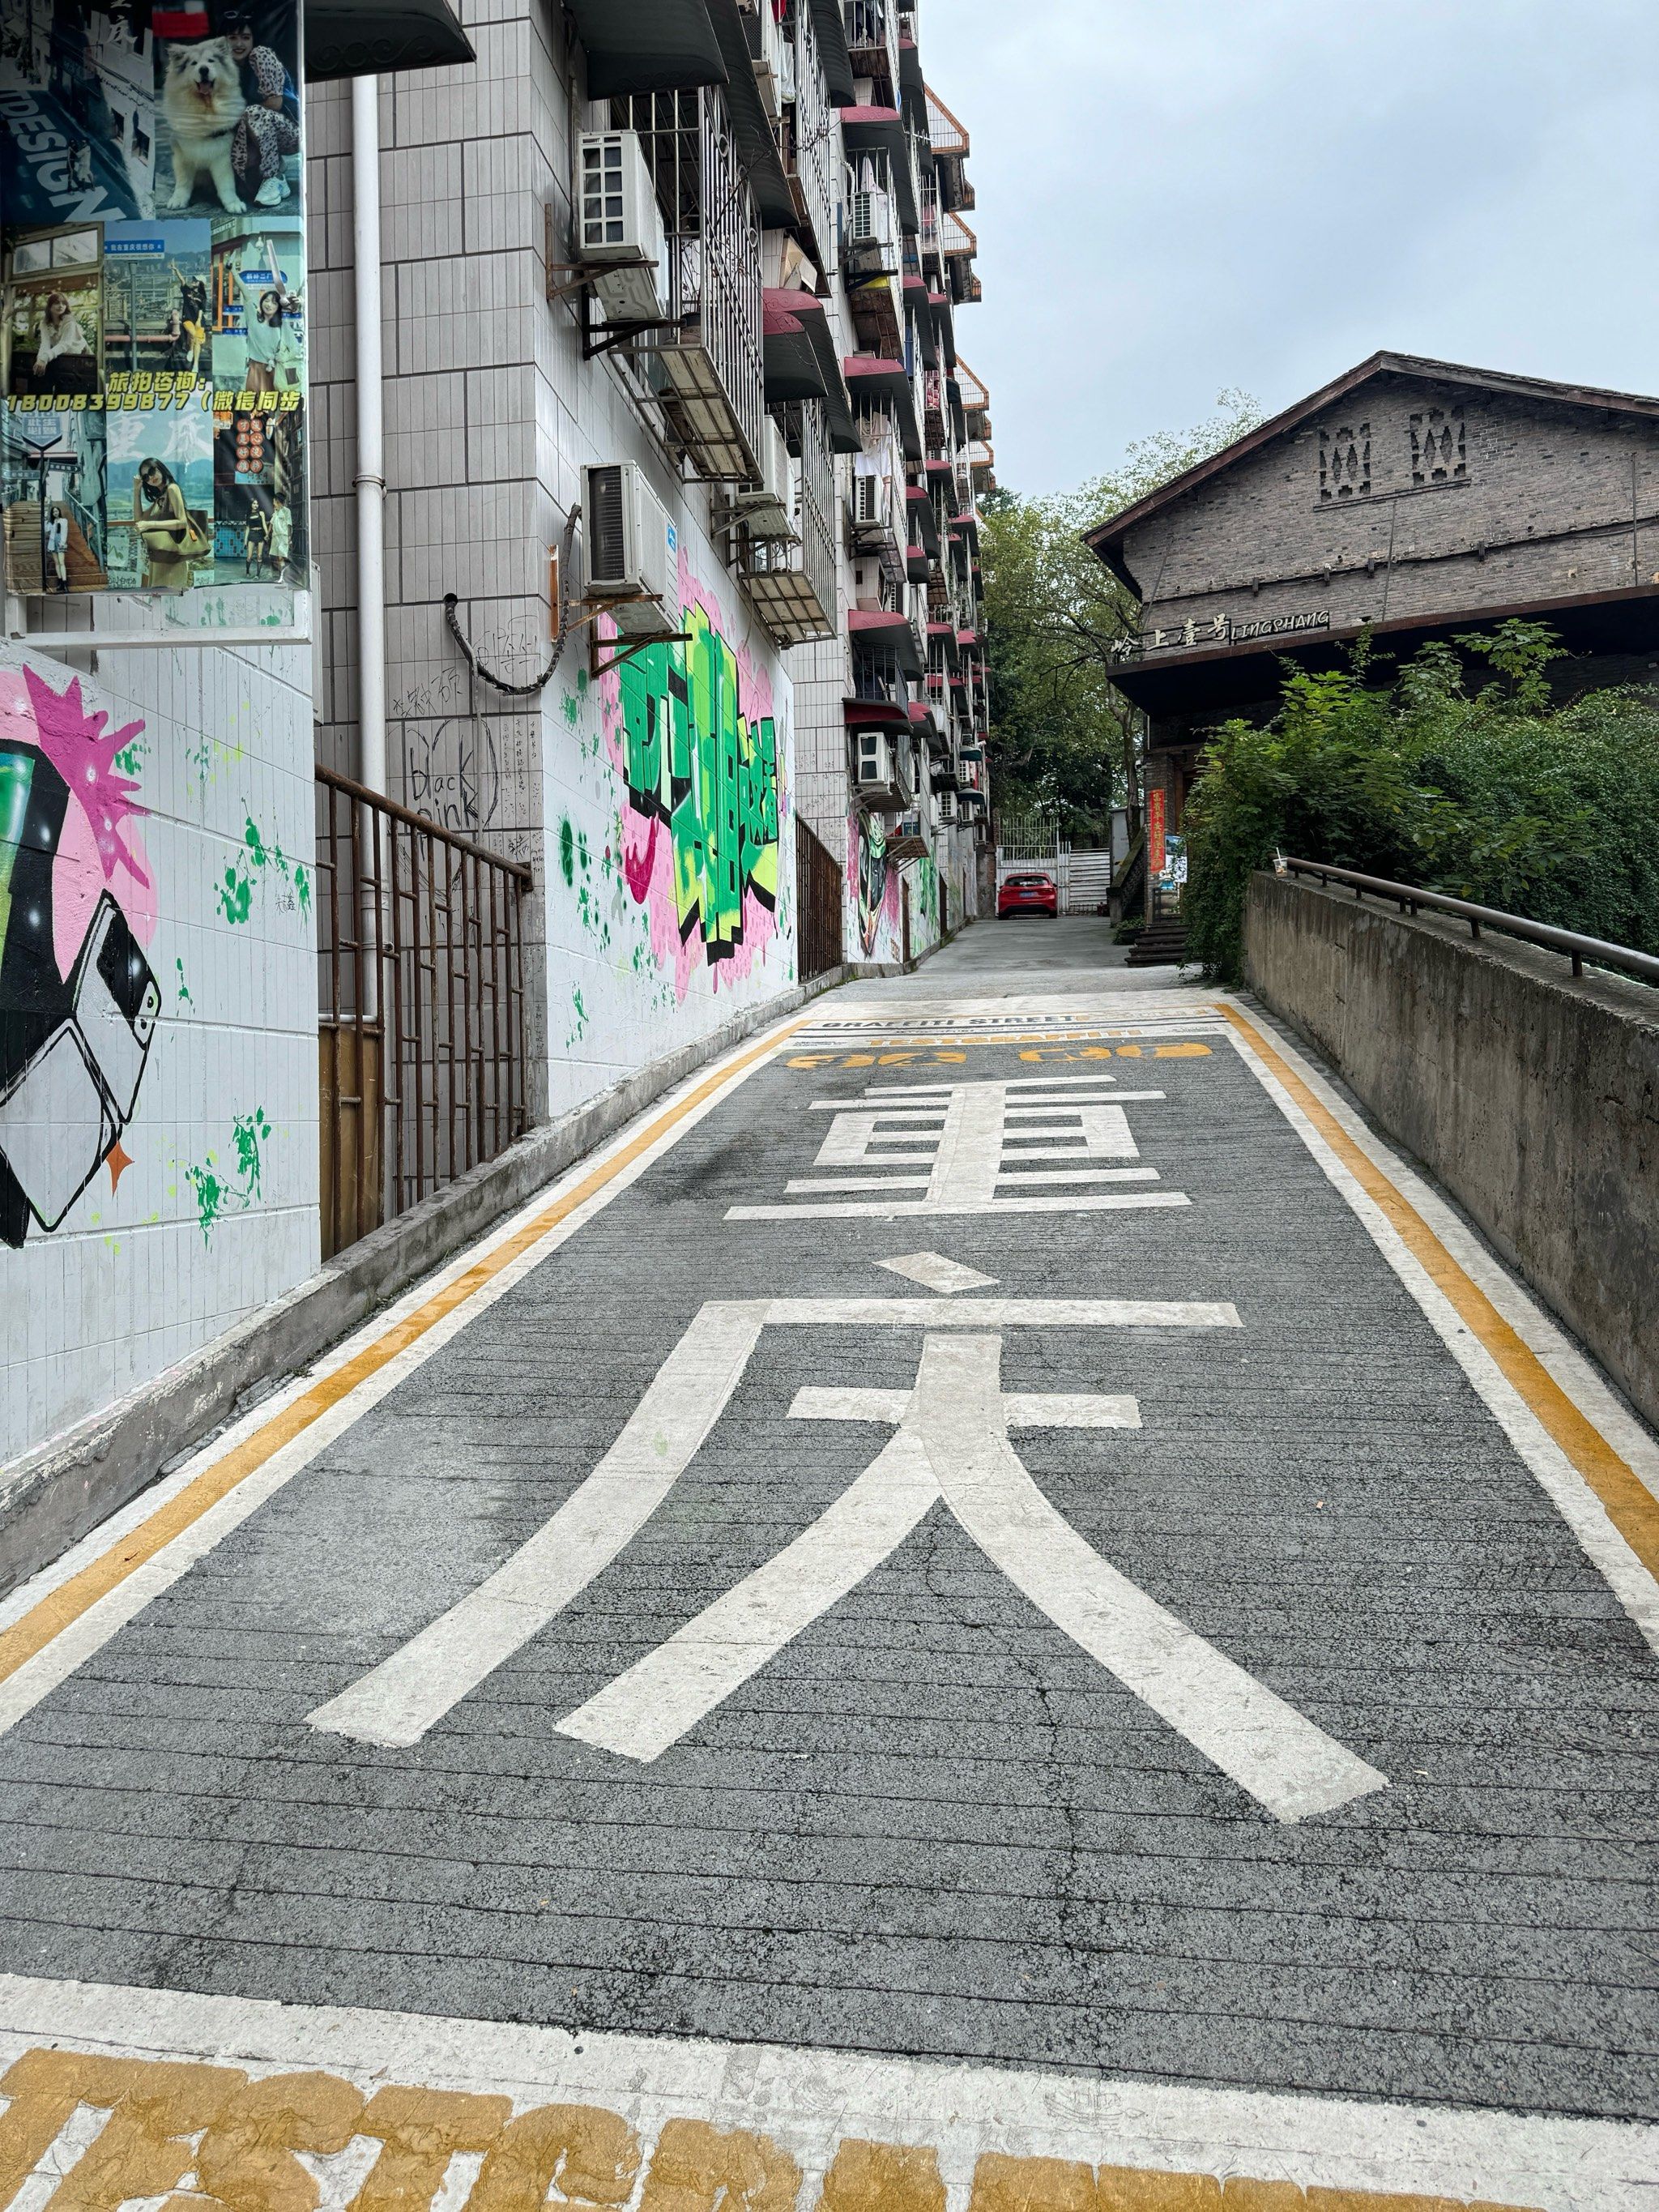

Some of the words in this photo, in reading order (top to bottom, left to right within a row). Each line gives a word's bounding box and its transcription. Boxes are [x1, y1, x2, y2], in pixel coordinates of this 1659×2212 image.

[7, 393, 190, 412] 18008399877
[1111, 613, 1230, 655] 岭上壹号
[1231, 610, 1328, 640] LINGSHANG
[821, 1019, 955, 1028] GRAFFITI
[969, 1014, 1073, 1025] STREET
[307, 1075, 1390, 1826] 重庆
